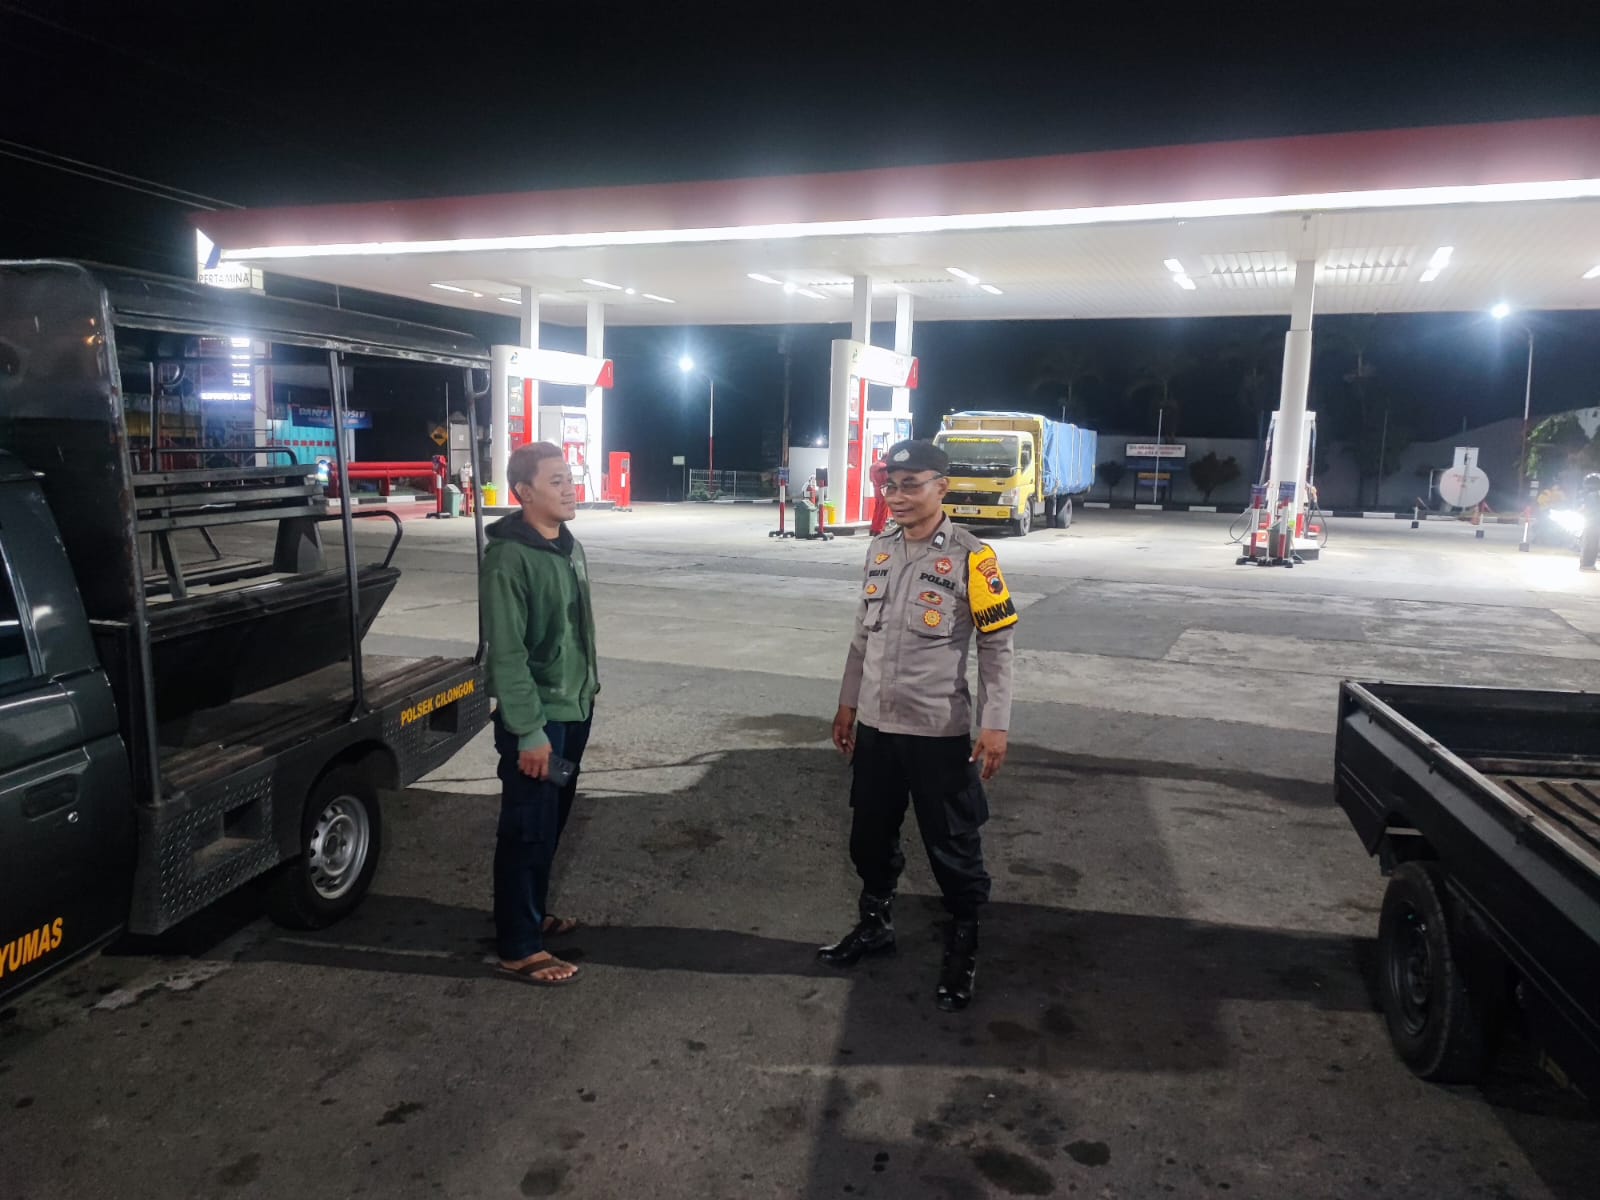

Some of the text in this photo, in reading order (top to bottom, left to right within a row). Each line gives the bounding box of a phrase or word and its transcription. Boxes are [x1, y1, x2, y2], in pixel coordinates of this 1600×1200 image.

[198, 271, 250, 284] PERTAMINA
[919, 572, 956, 591] POLRI
[401, 679, 475, 727] POLSEK CILONGOK
